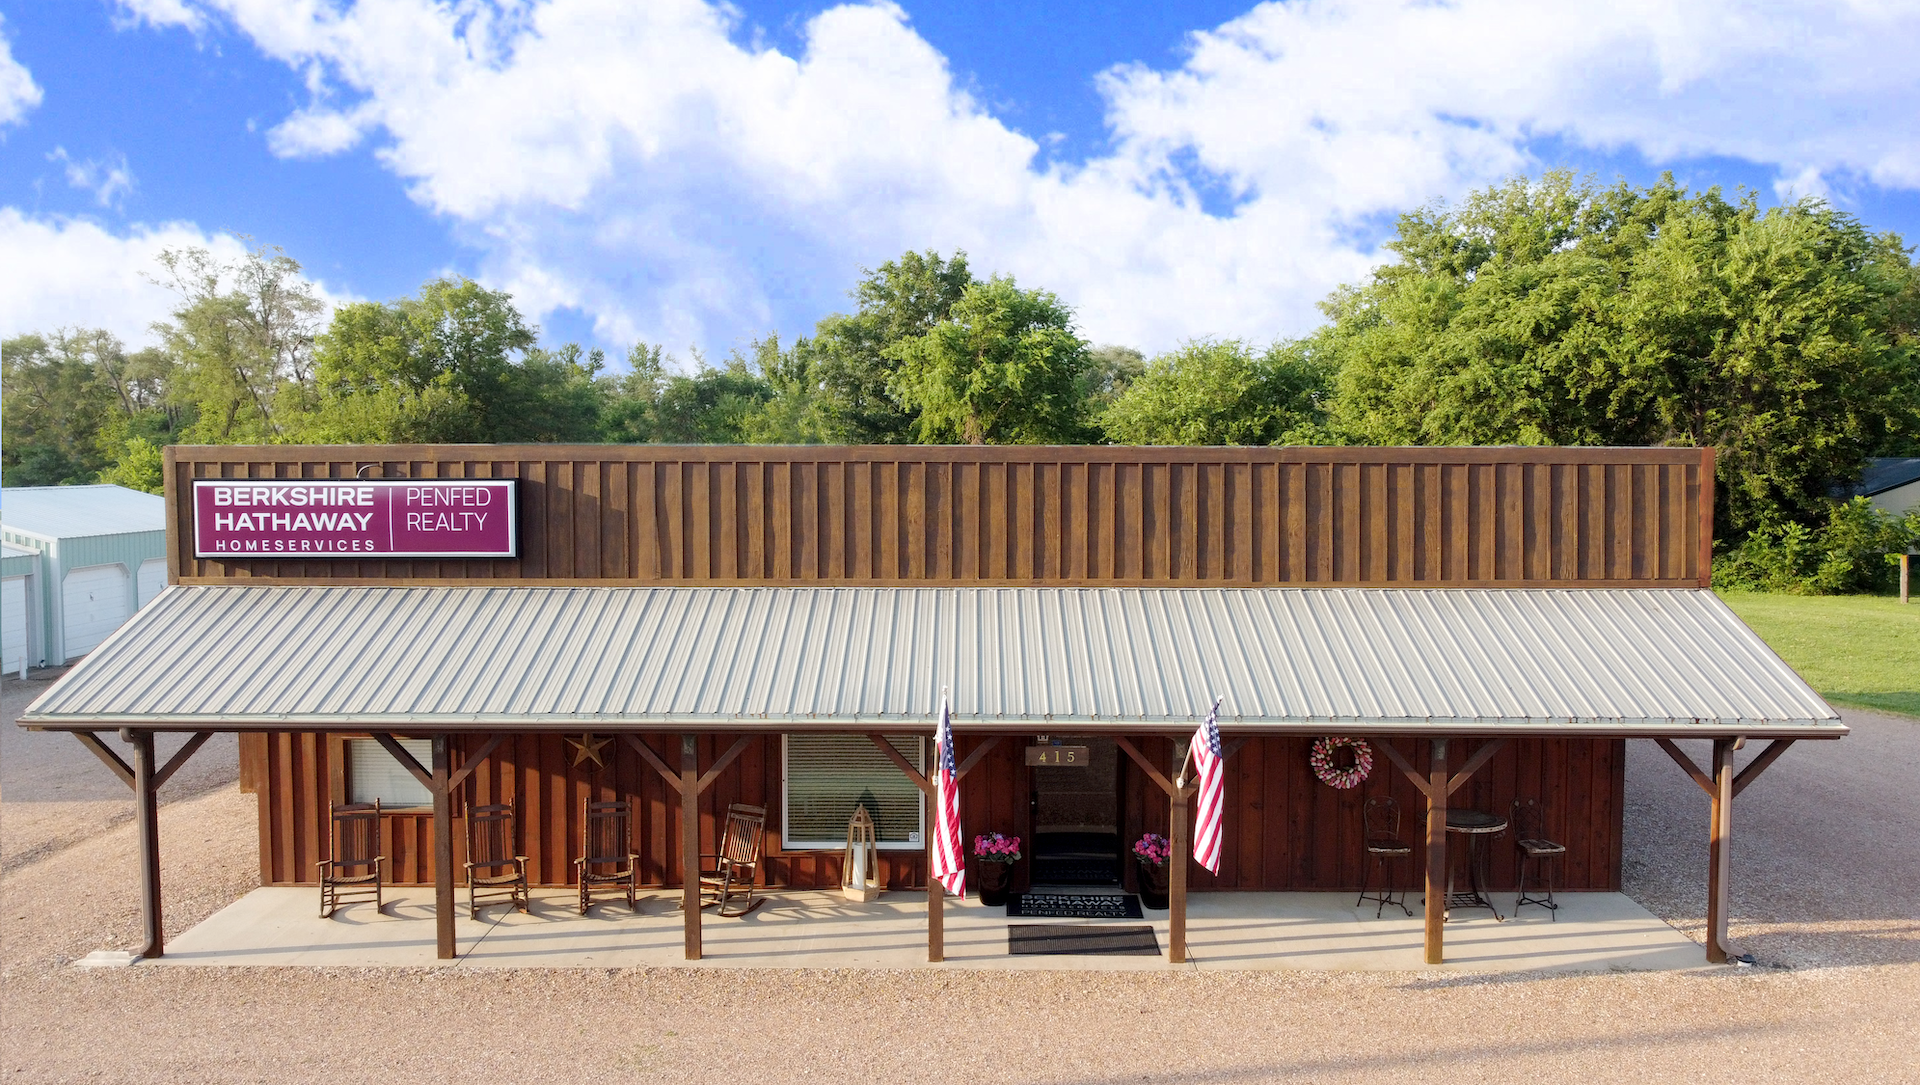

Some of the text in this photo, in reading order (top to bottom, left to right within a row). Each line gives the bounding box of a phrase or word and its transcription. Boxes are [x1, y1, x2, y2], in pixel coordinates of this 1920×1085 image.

[214, 487, 374, 506] BERKSHIRE
[406, 487, 491, 506] PENFED
[214, 512, 374, 531] HATHAWAY
[406, 512, 488, 531] REALTY
[215, 539, 375, 551] HOMESERVICES
